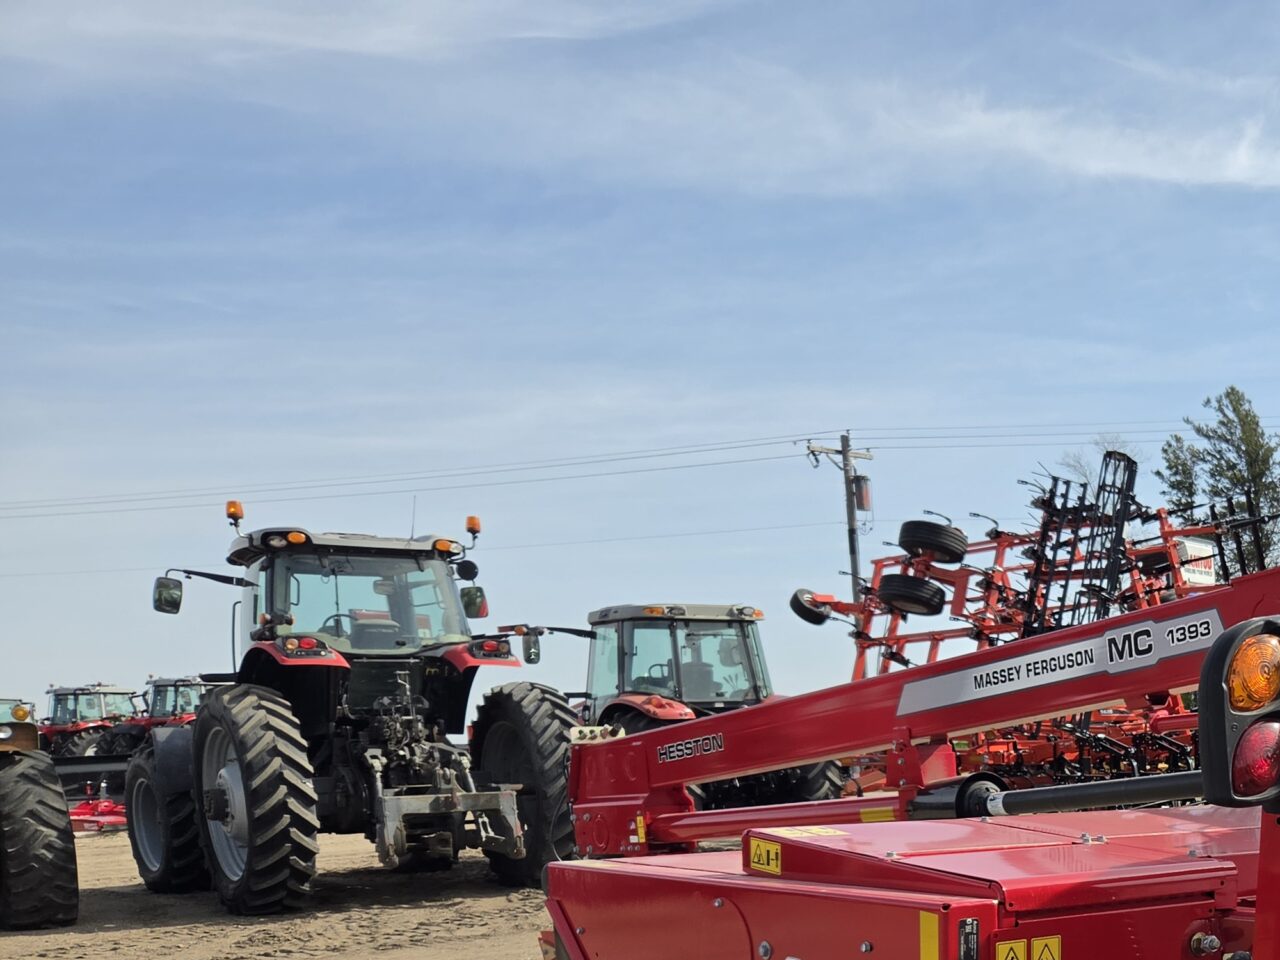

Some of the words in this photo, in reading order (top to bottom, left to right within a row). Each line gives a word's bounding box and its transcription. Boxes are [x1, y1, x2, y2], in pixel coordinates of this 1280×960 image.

[973, 664, 1022, 690] MASSEY
[1026, 648, 1095, 678] FERGUSON
[1106, 629, 1154, 664] MC
[1165, 620, 1212, 646] 1393
[657, 732, 725, 763] HESSTON
